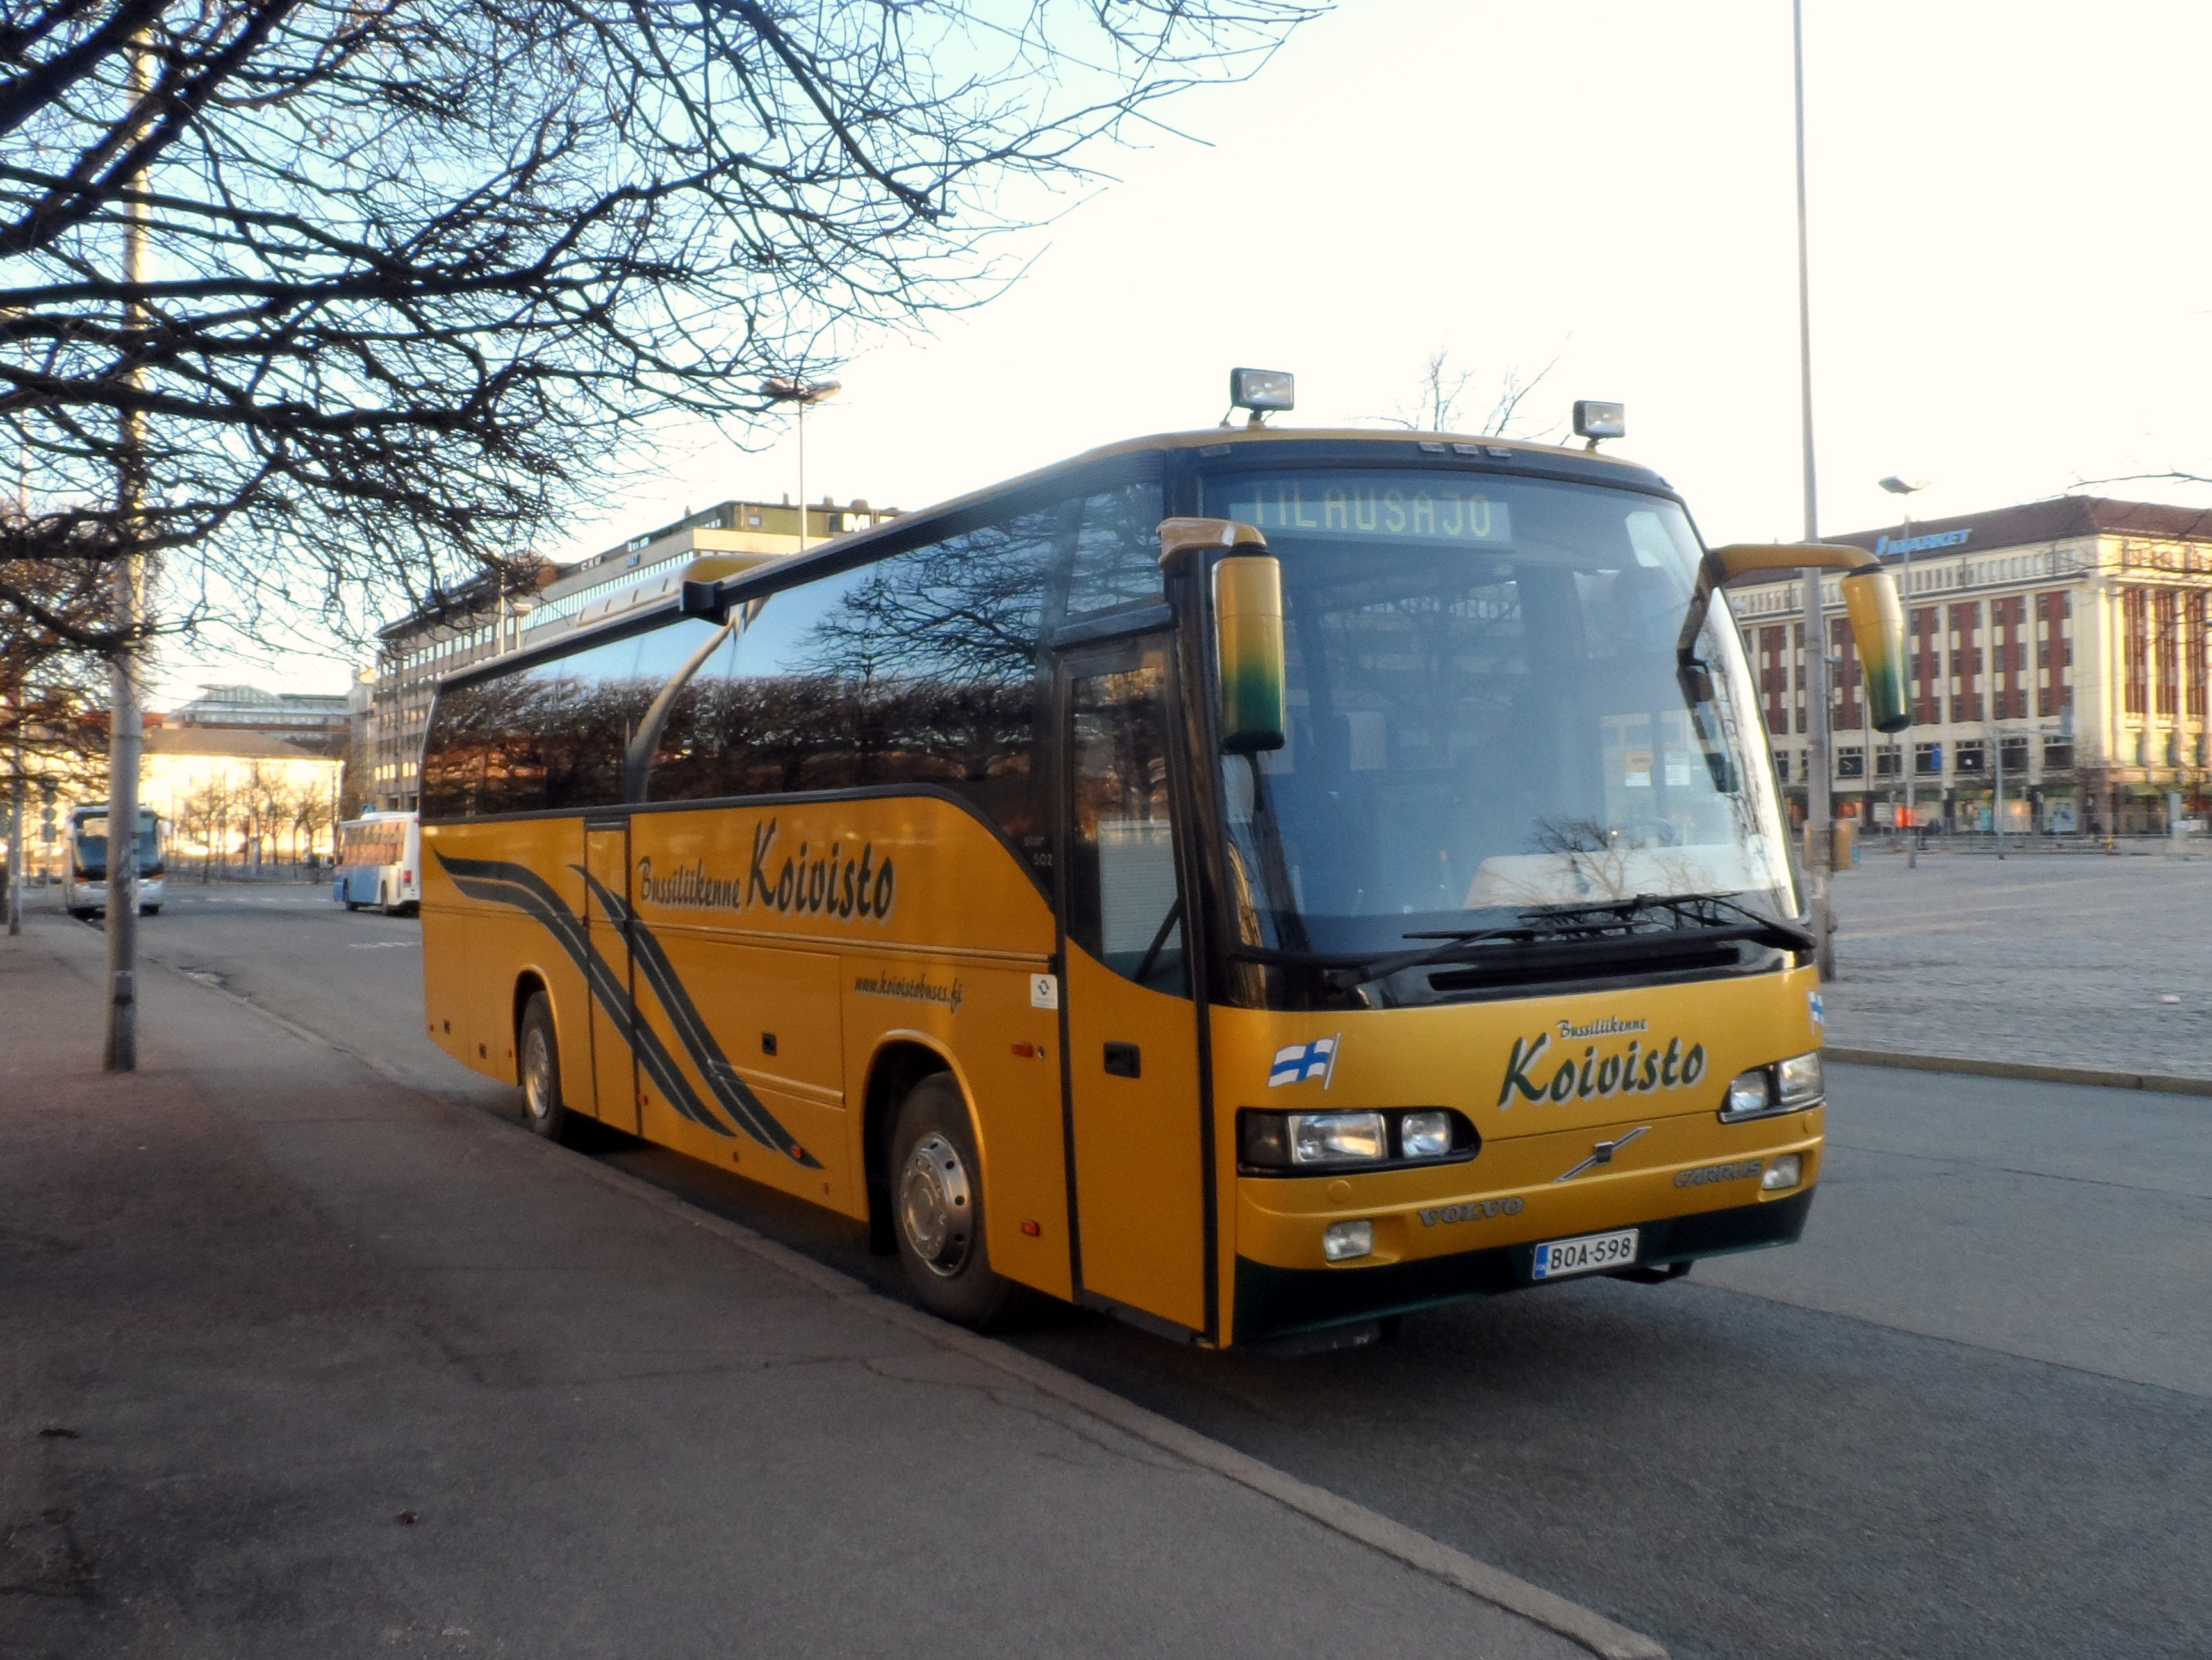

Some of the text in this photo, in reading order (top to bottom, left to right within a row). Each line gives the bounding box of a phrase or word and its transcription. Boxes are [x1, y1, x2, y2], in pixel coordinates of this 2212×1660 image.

[1253, 482, 1492, 537] TILAUSAJO
[747, 817, 894, 924] Koivisto
[1556, 1015, 1648, 1039] Bussiliikenne
[1497, 1033, 1708, 1109] Koivisto
[1418, 1196, 1524, 1226] VOLVO
[1551, 1237, 1631, 1270] BOA-598
